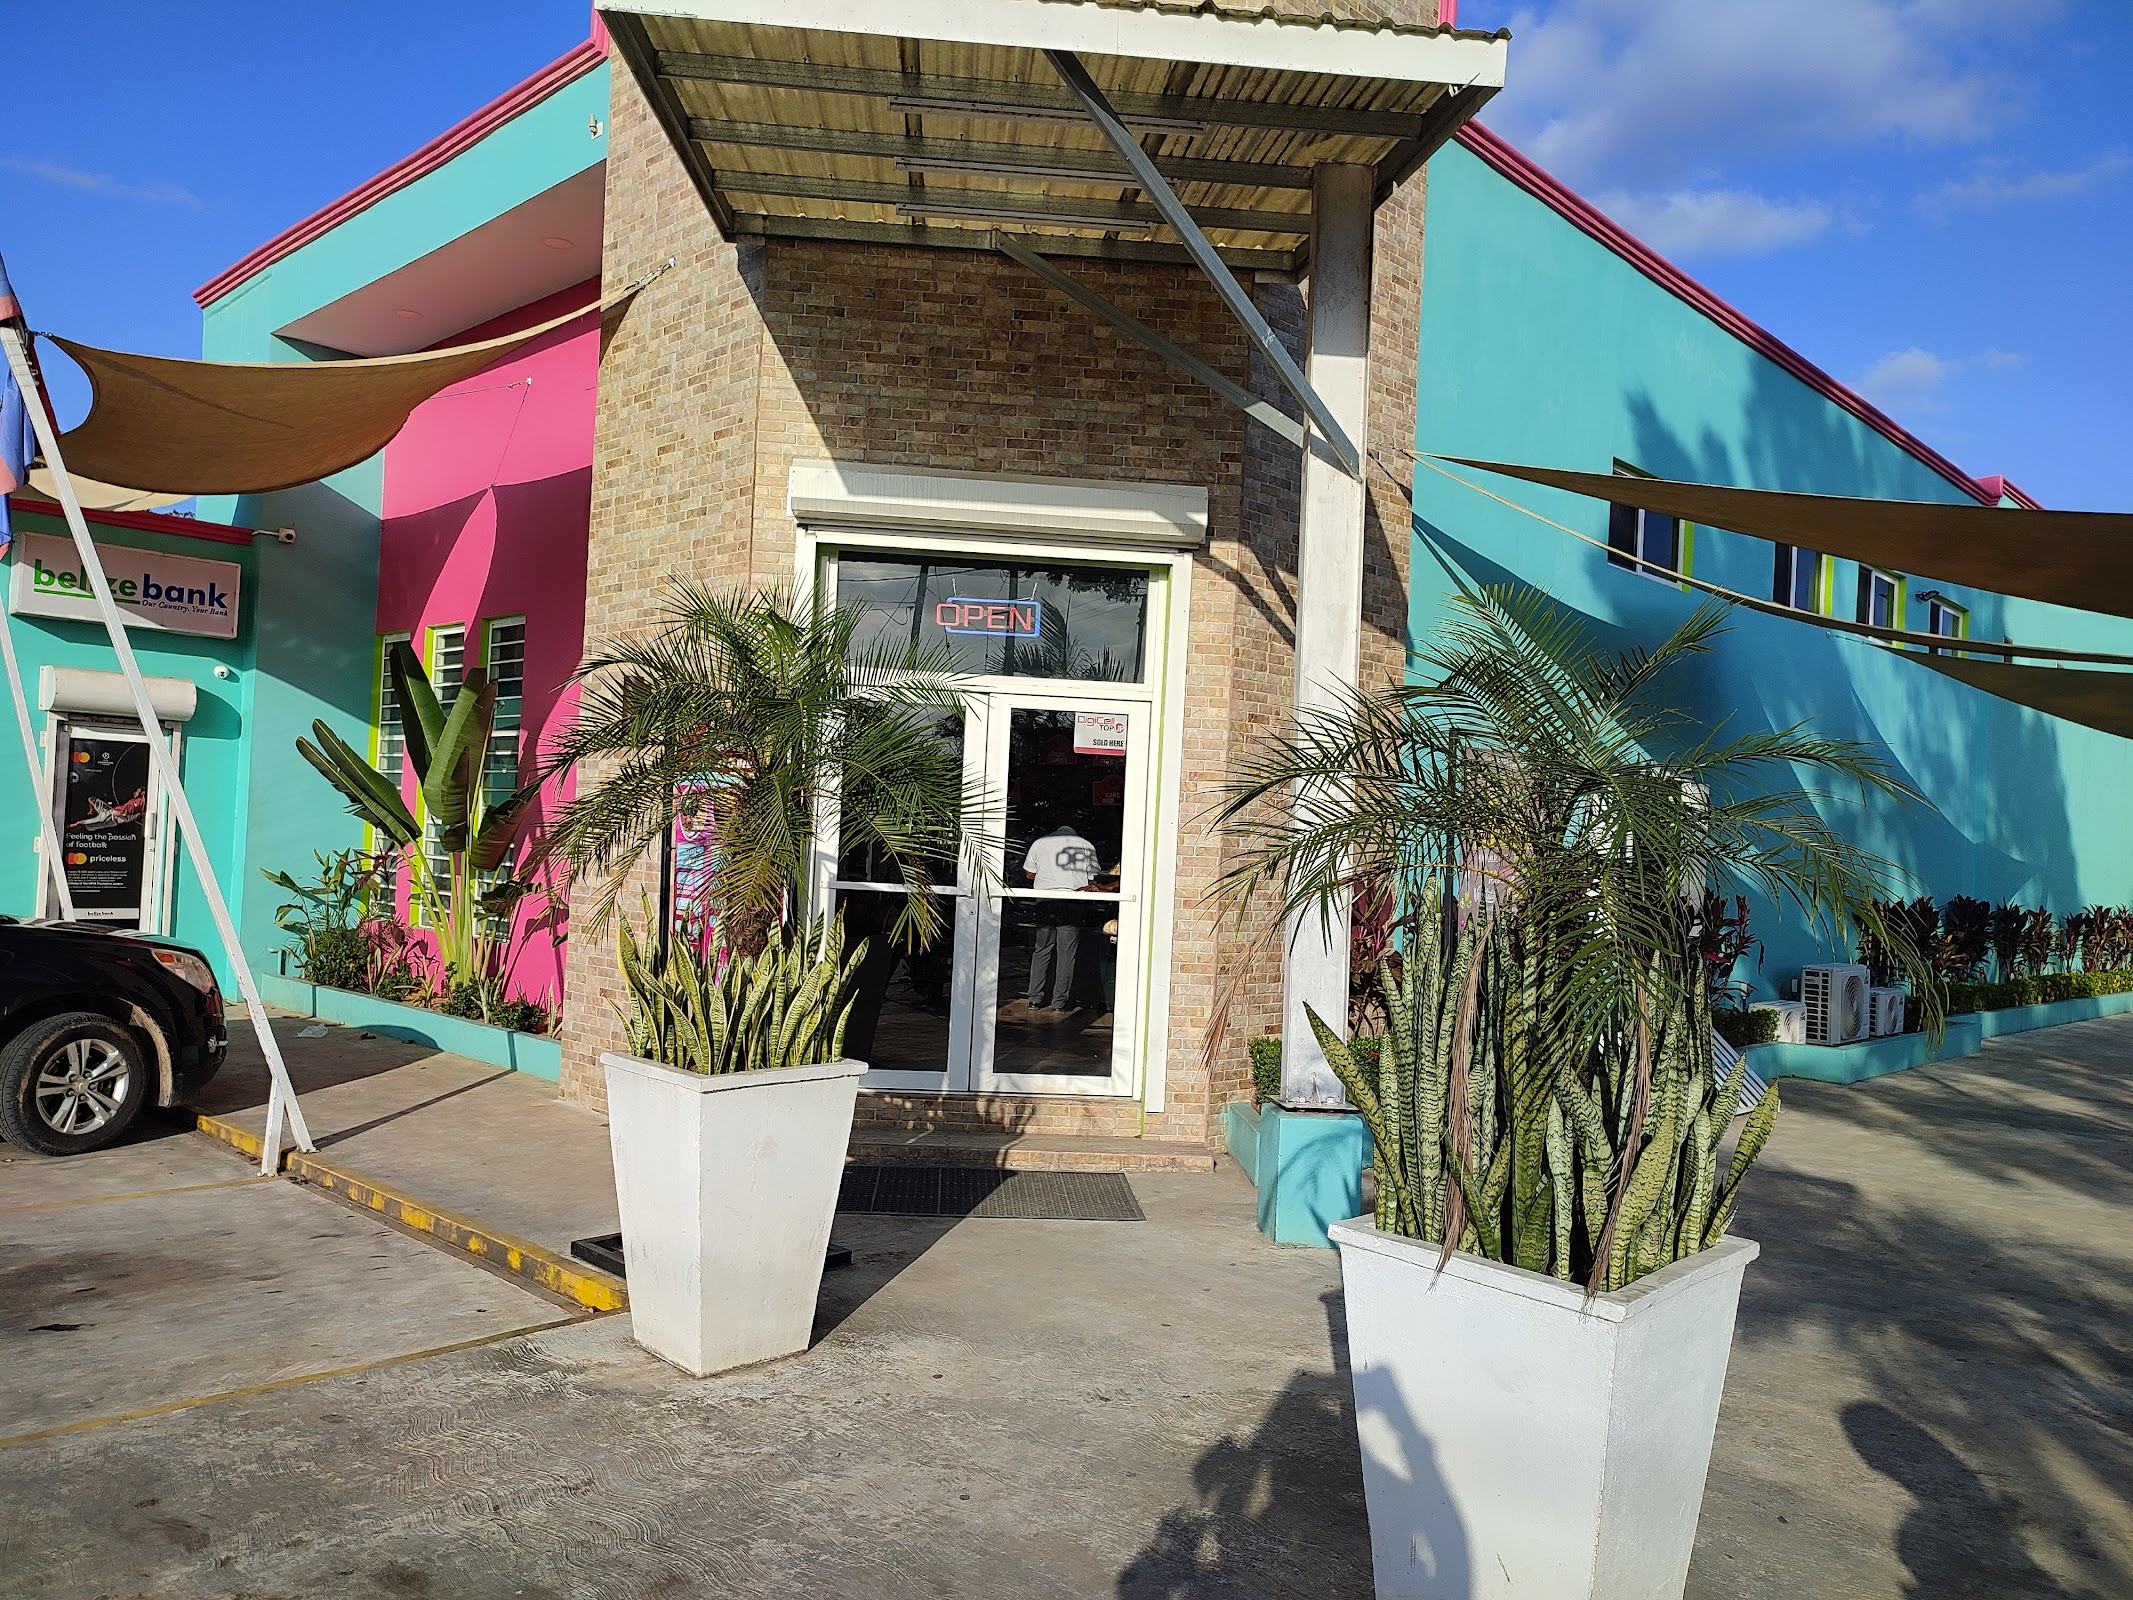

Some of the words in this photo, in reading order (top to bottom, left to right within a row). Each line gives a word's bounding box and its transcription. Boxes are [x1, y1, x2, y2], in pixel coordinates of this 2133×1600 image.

[141, 599, 157, 608] Our
[191, 605, 208, 614] Your
[209, 608, 228, 617] Bank
[936, 603, 1033, 631] OPEN
[1109, 740, 1124, 748] HERE
[66, 832, 93, 841] Feeling
[89, 854, 127, 863] priceless
